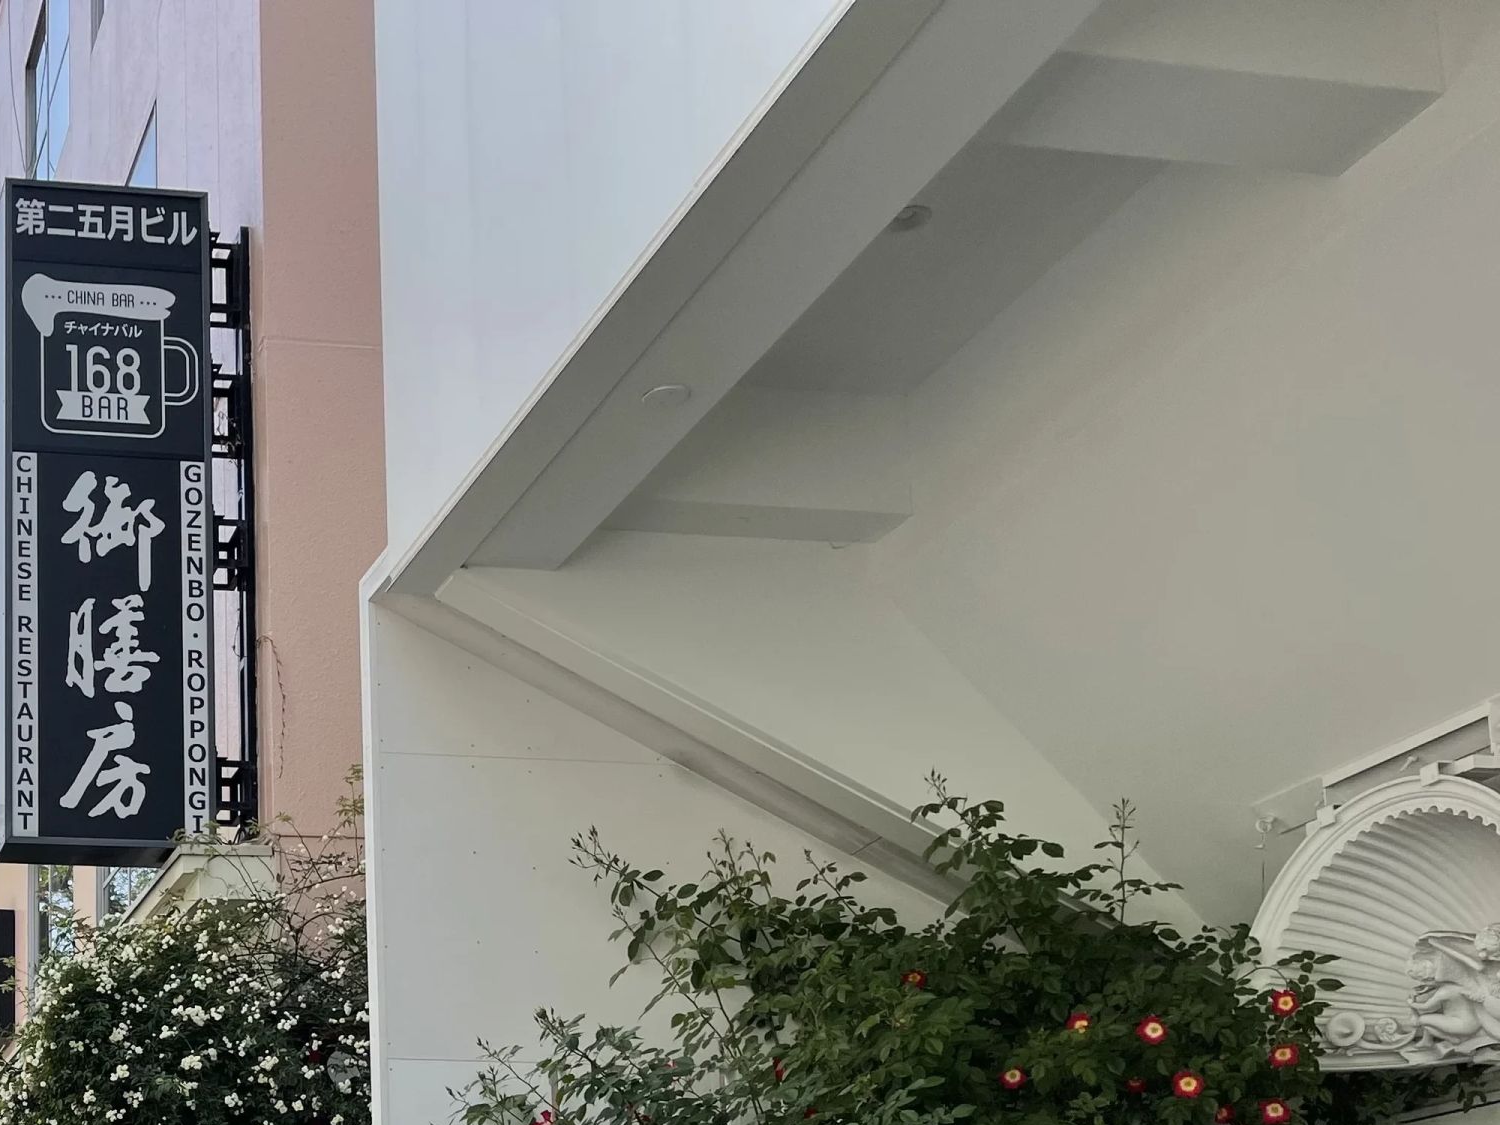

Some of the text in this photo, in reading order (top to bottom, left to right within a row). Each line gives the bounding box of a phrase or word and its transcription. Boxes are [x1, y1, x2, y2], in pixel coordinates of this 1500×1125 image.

[15, 198, 198, 246] 第二五月ビル
[67, 290, 135, 308] CHINA BAR
[63, 320, 143, 338] チャイナバル
[65, 344, 141, 395] 168
[82, 396, 129, 420] BAR
[16, 455, 34, 831] CHINESE RESTAURANT
[60, 470, 166, 819] 御膳房
